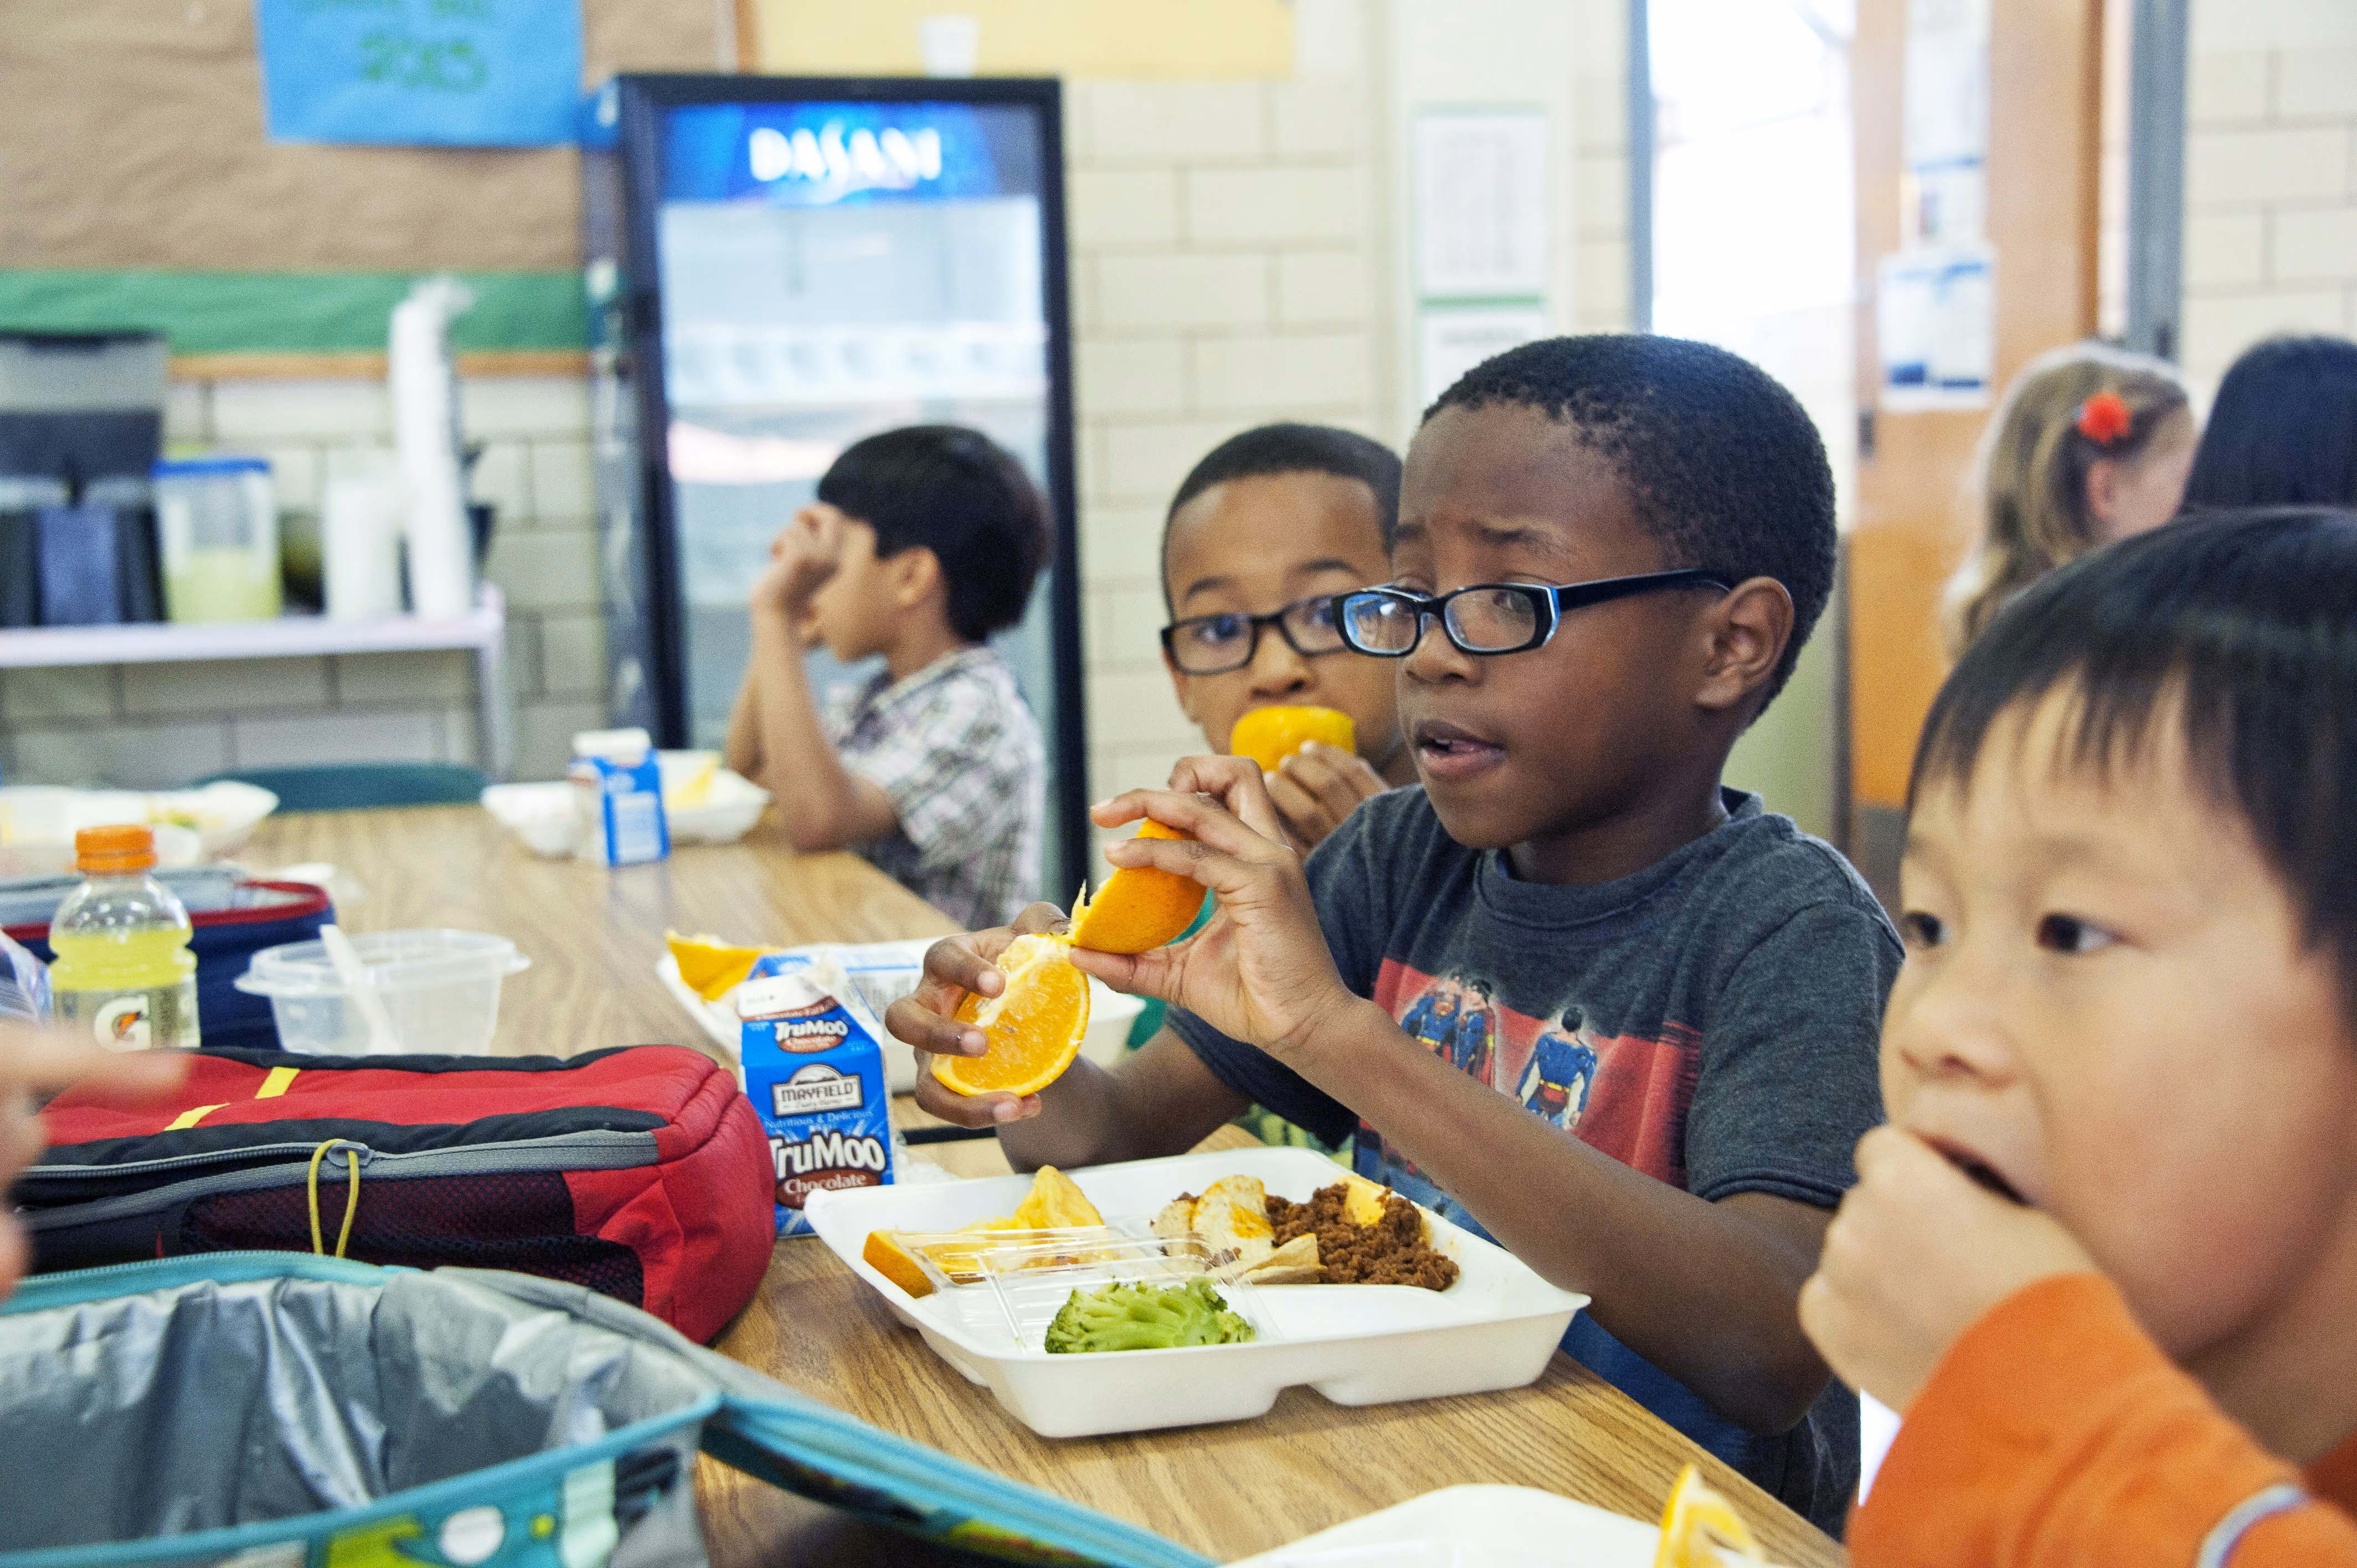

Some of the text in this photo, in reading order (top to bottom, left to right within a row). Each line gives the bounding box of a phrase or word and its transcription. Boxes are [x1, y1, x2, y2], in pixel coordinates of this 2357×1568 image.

[774, 1019, 849, 1042] TruMoo
[781, 1081, 853, 1102] MAYFIELD
[784, 1174, 868, 1195] Chocolate
